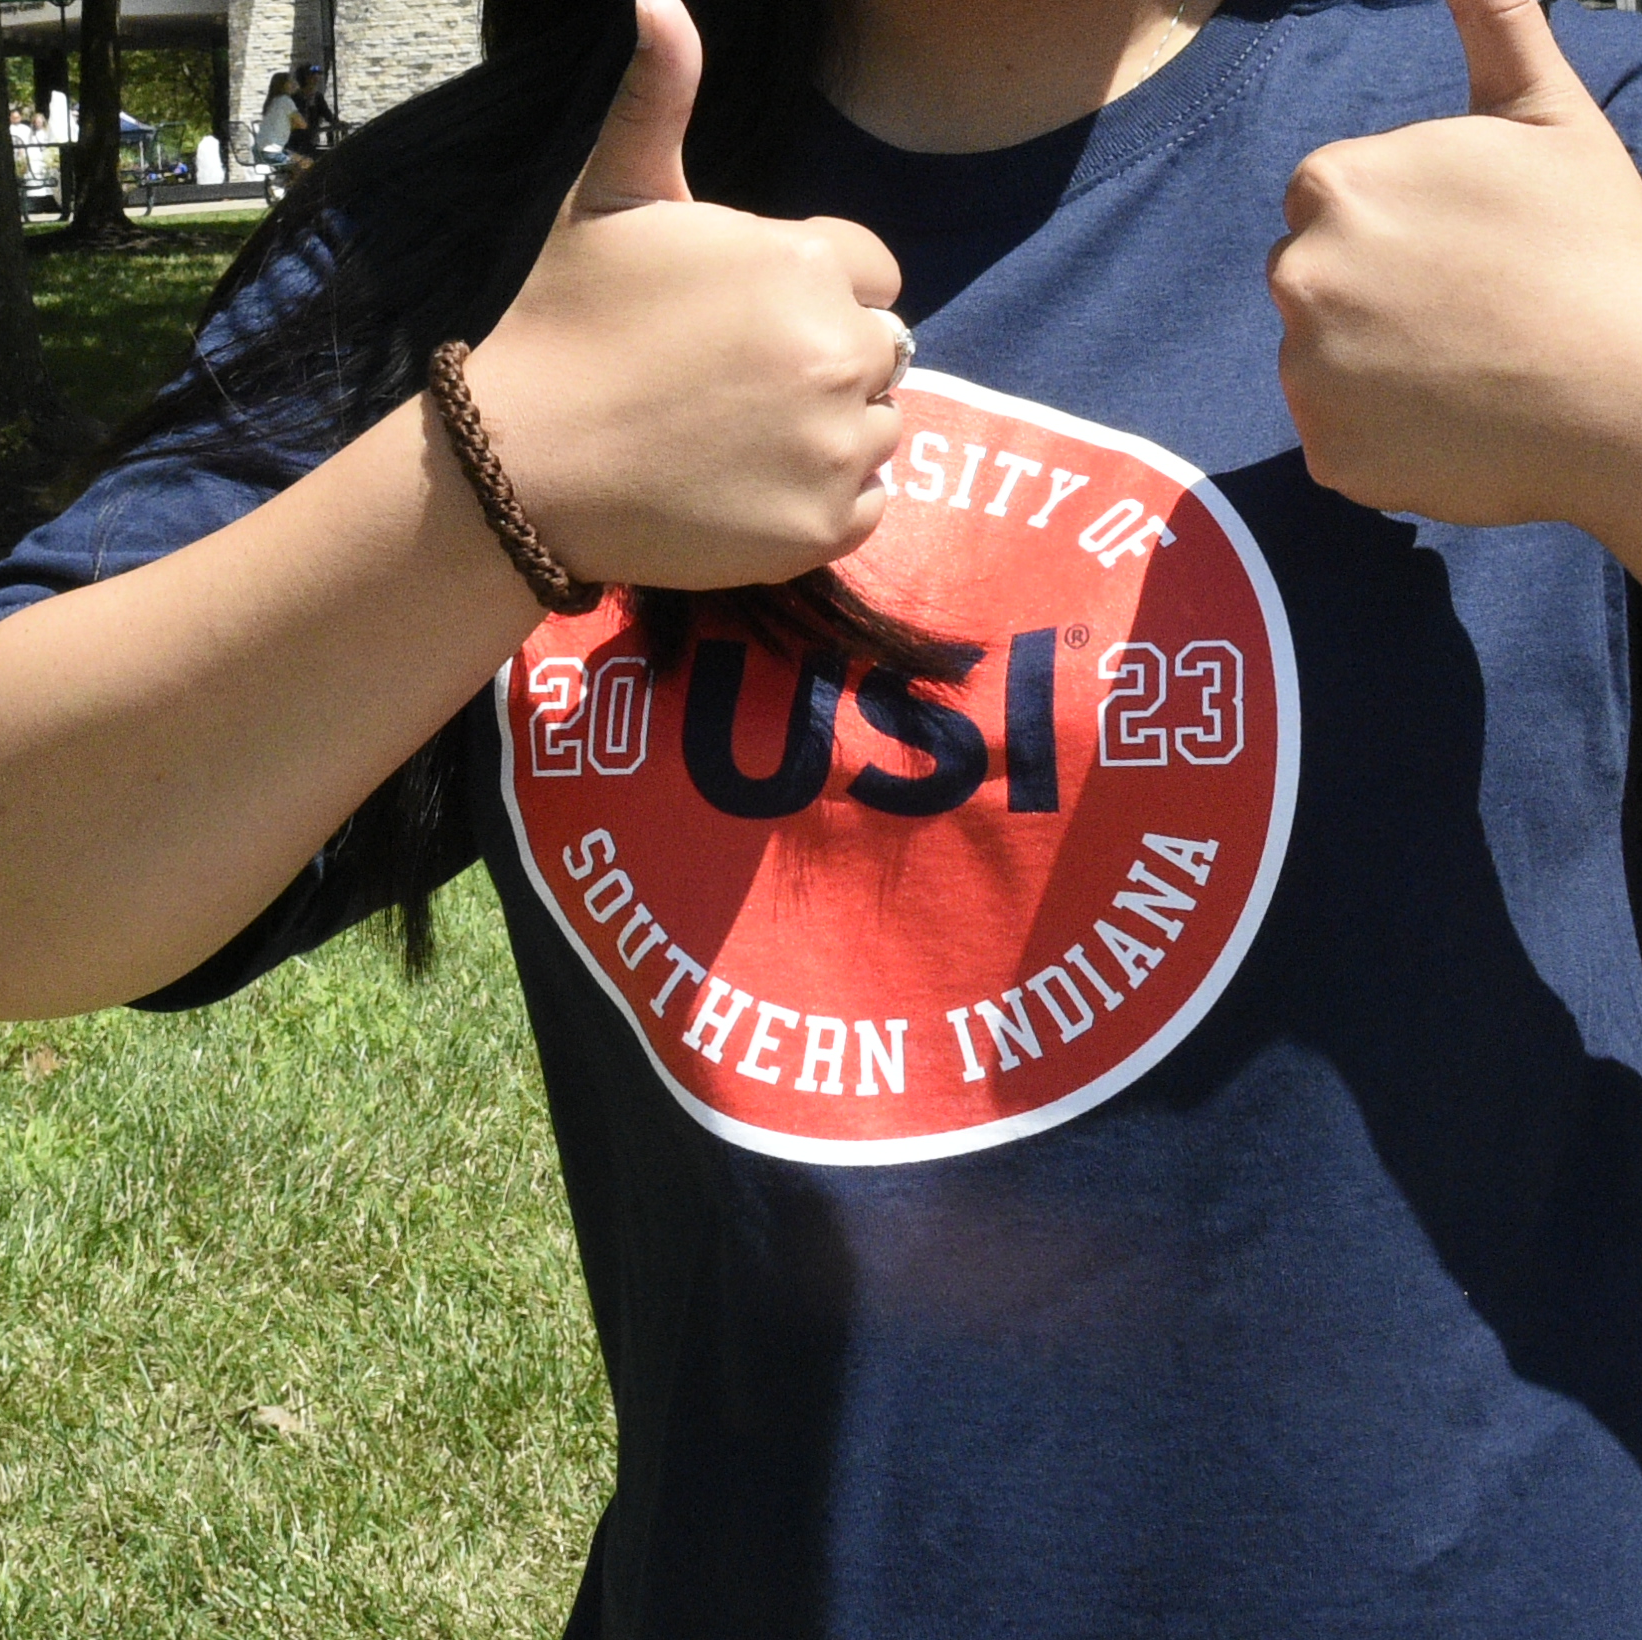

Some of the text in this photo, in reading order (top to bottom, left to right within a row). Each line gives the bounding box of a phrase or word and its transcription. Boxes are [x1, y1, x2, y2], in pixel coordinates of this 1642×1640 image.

[1078, 498, 1178, 567] OF
[529, 656, 653, 777] 20
[1097, 639, 1245, 767] 23
[562, 827, 1219, 1097] SOUTHERN INDIANA
